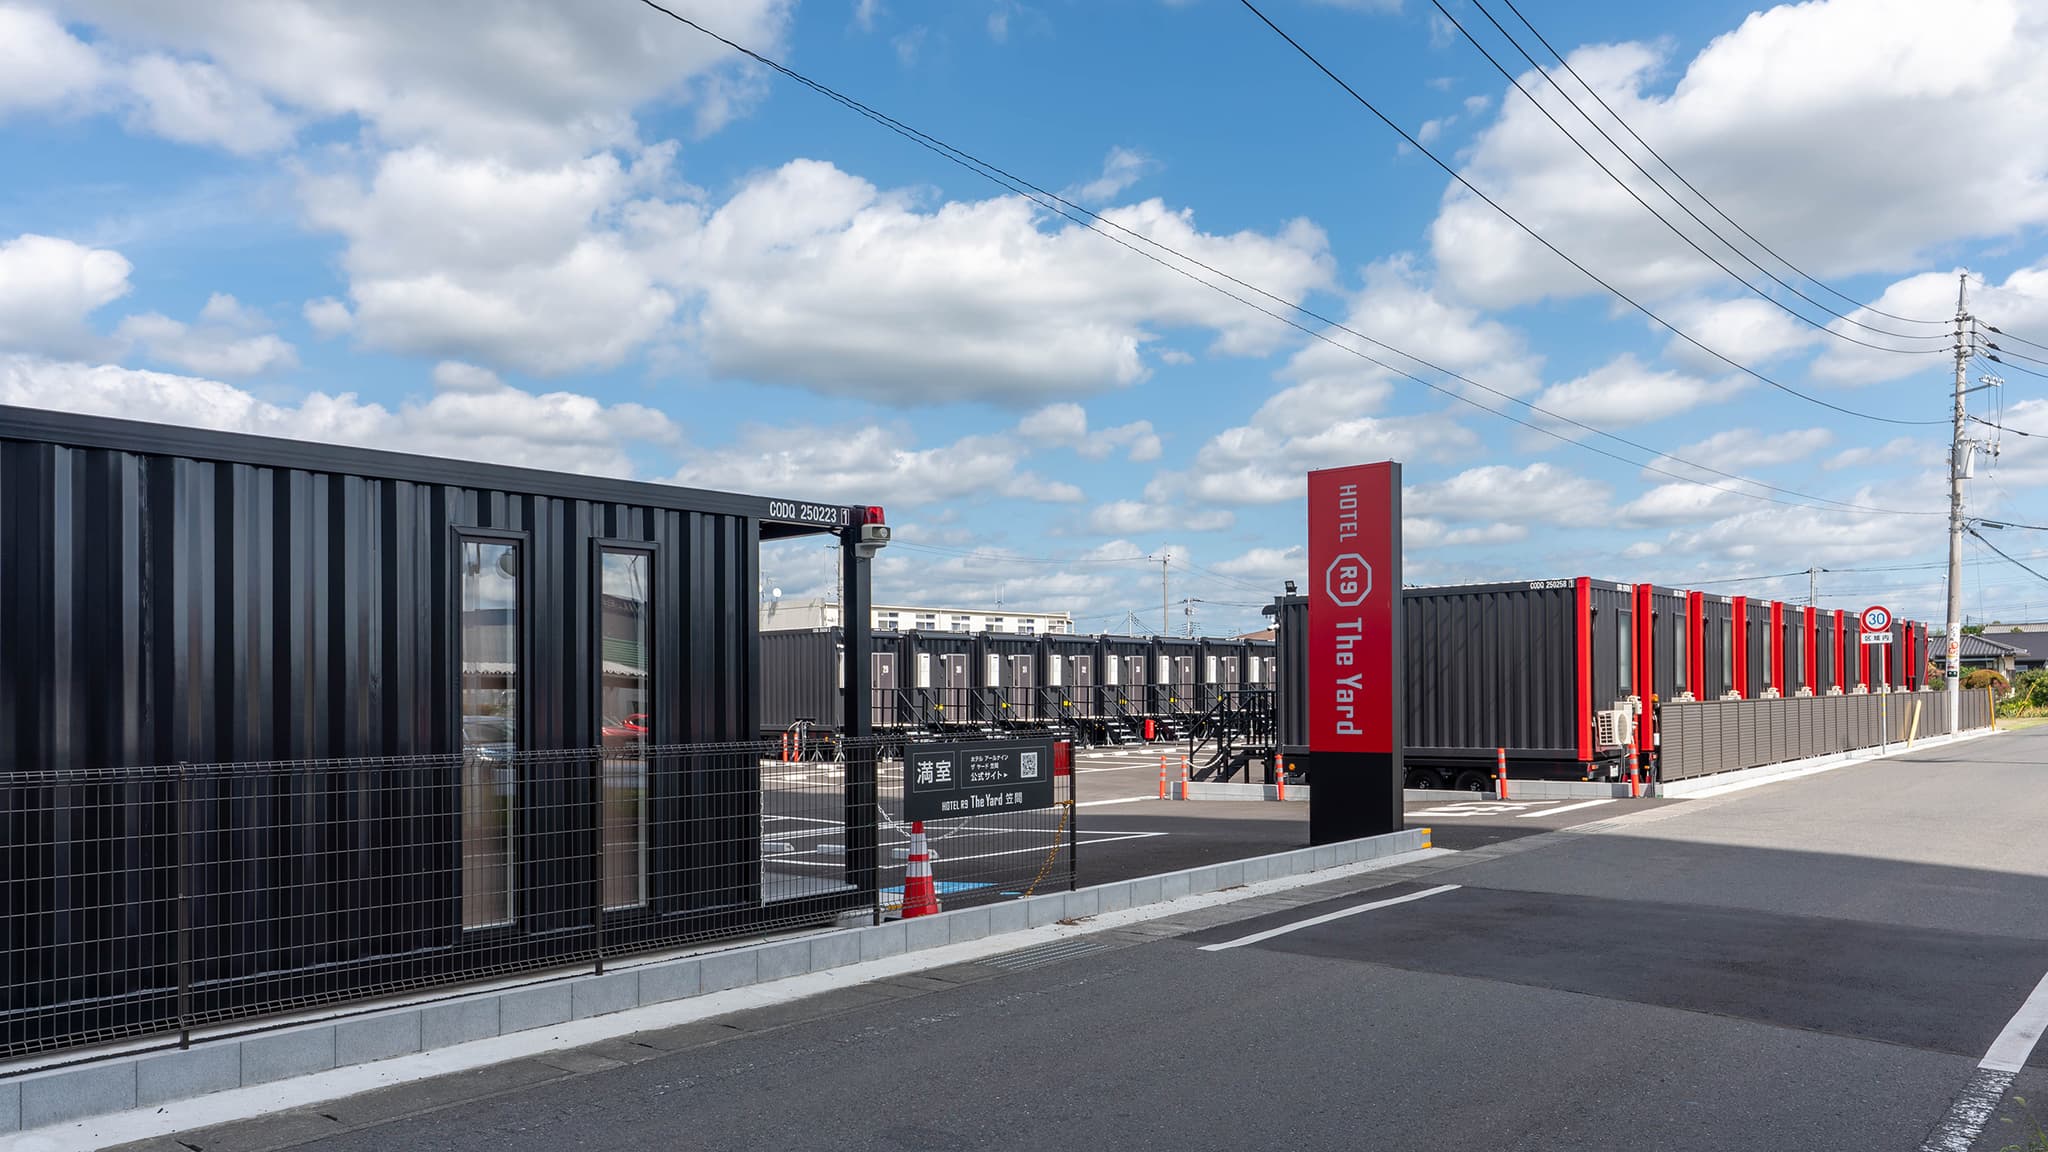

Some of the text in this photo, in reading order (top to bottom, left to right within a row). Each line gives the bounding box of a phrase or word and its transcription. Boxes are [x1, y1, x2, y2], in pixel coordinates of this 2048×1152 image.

[769, 501, 796, 519] CODQ
[800, 504, 837, 523] 250223
[1335, 484, 1363, 735] HOTEL R9 The Yard
[1868, 613, 1885, 626] 30
[917, 760, 952, 785] 満室
[970, 770, 1003, 782] 公式サイト
[941, 791, 1023, 812] HOTEL R9 The Yard 笠間
